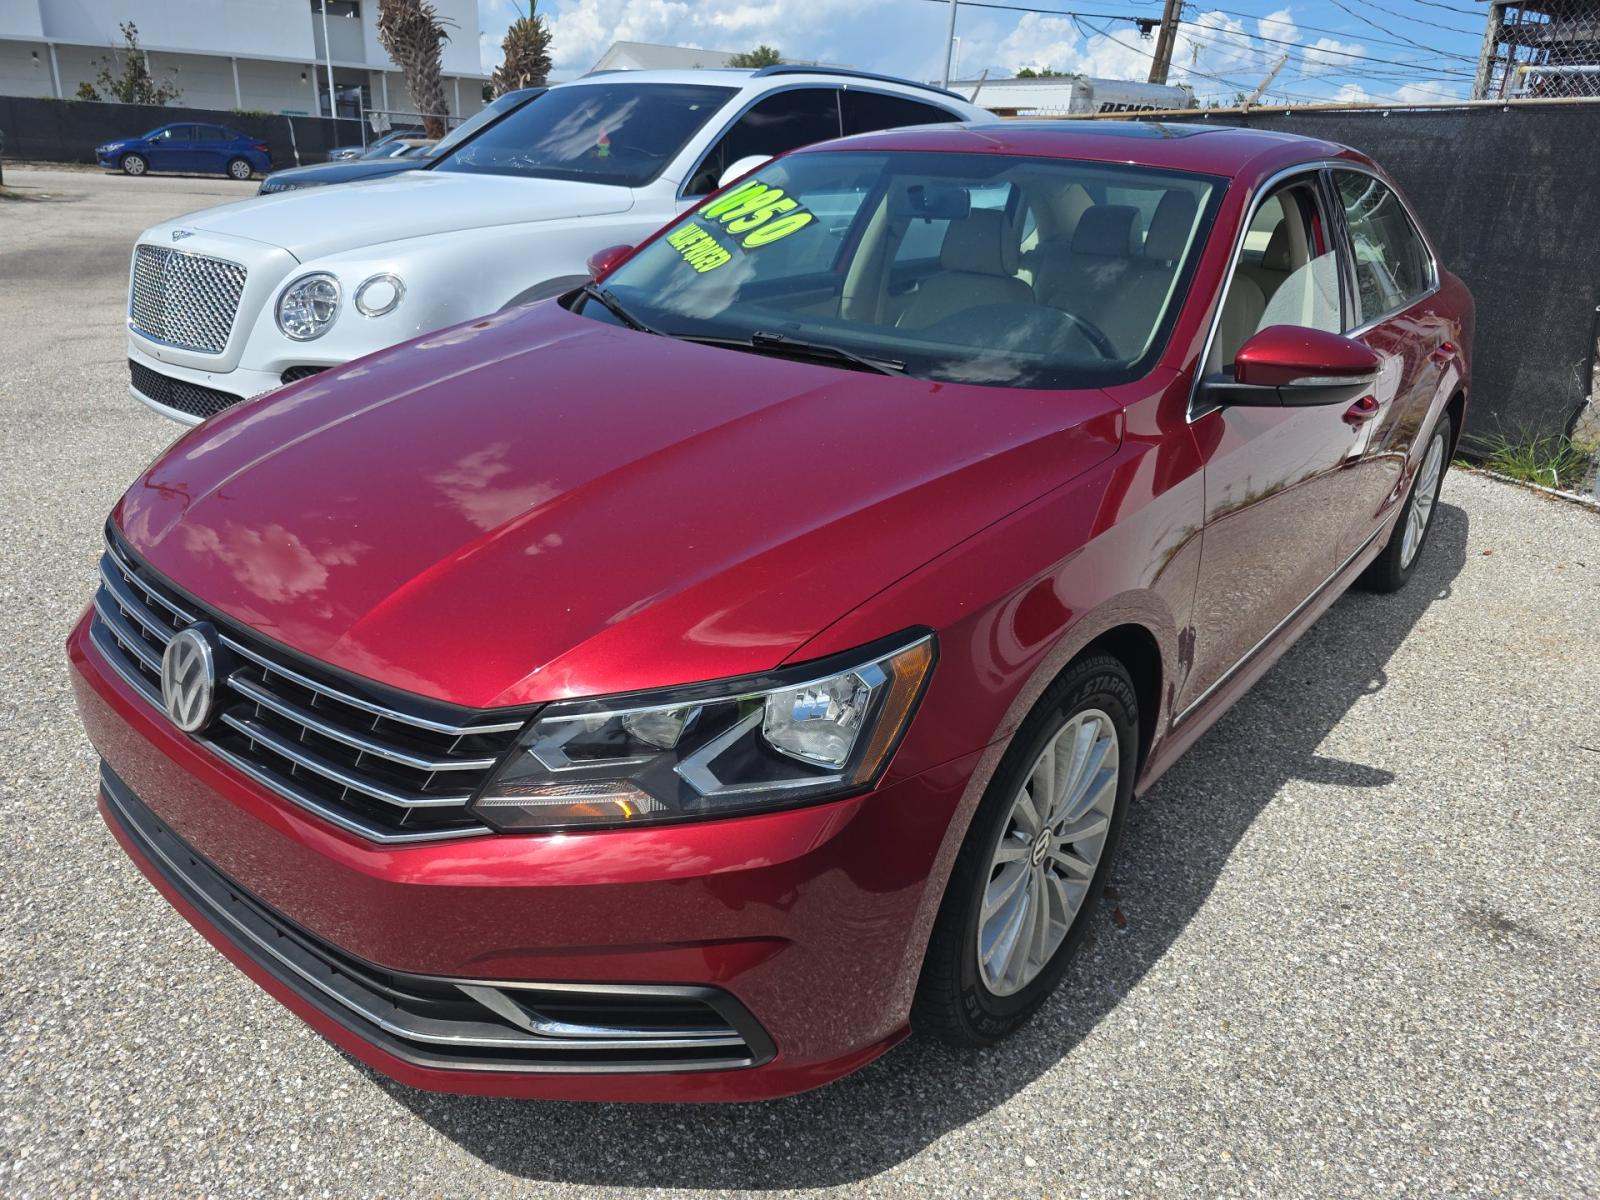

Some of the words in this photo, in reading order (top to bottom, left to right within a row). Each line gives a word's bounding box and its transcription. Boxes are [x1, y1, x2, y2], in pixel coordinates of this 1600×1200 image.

[699, 180, 812, 248] 10950
[681, 236, 731, 273] PRICED
[163, 630, 213, 731] VW
